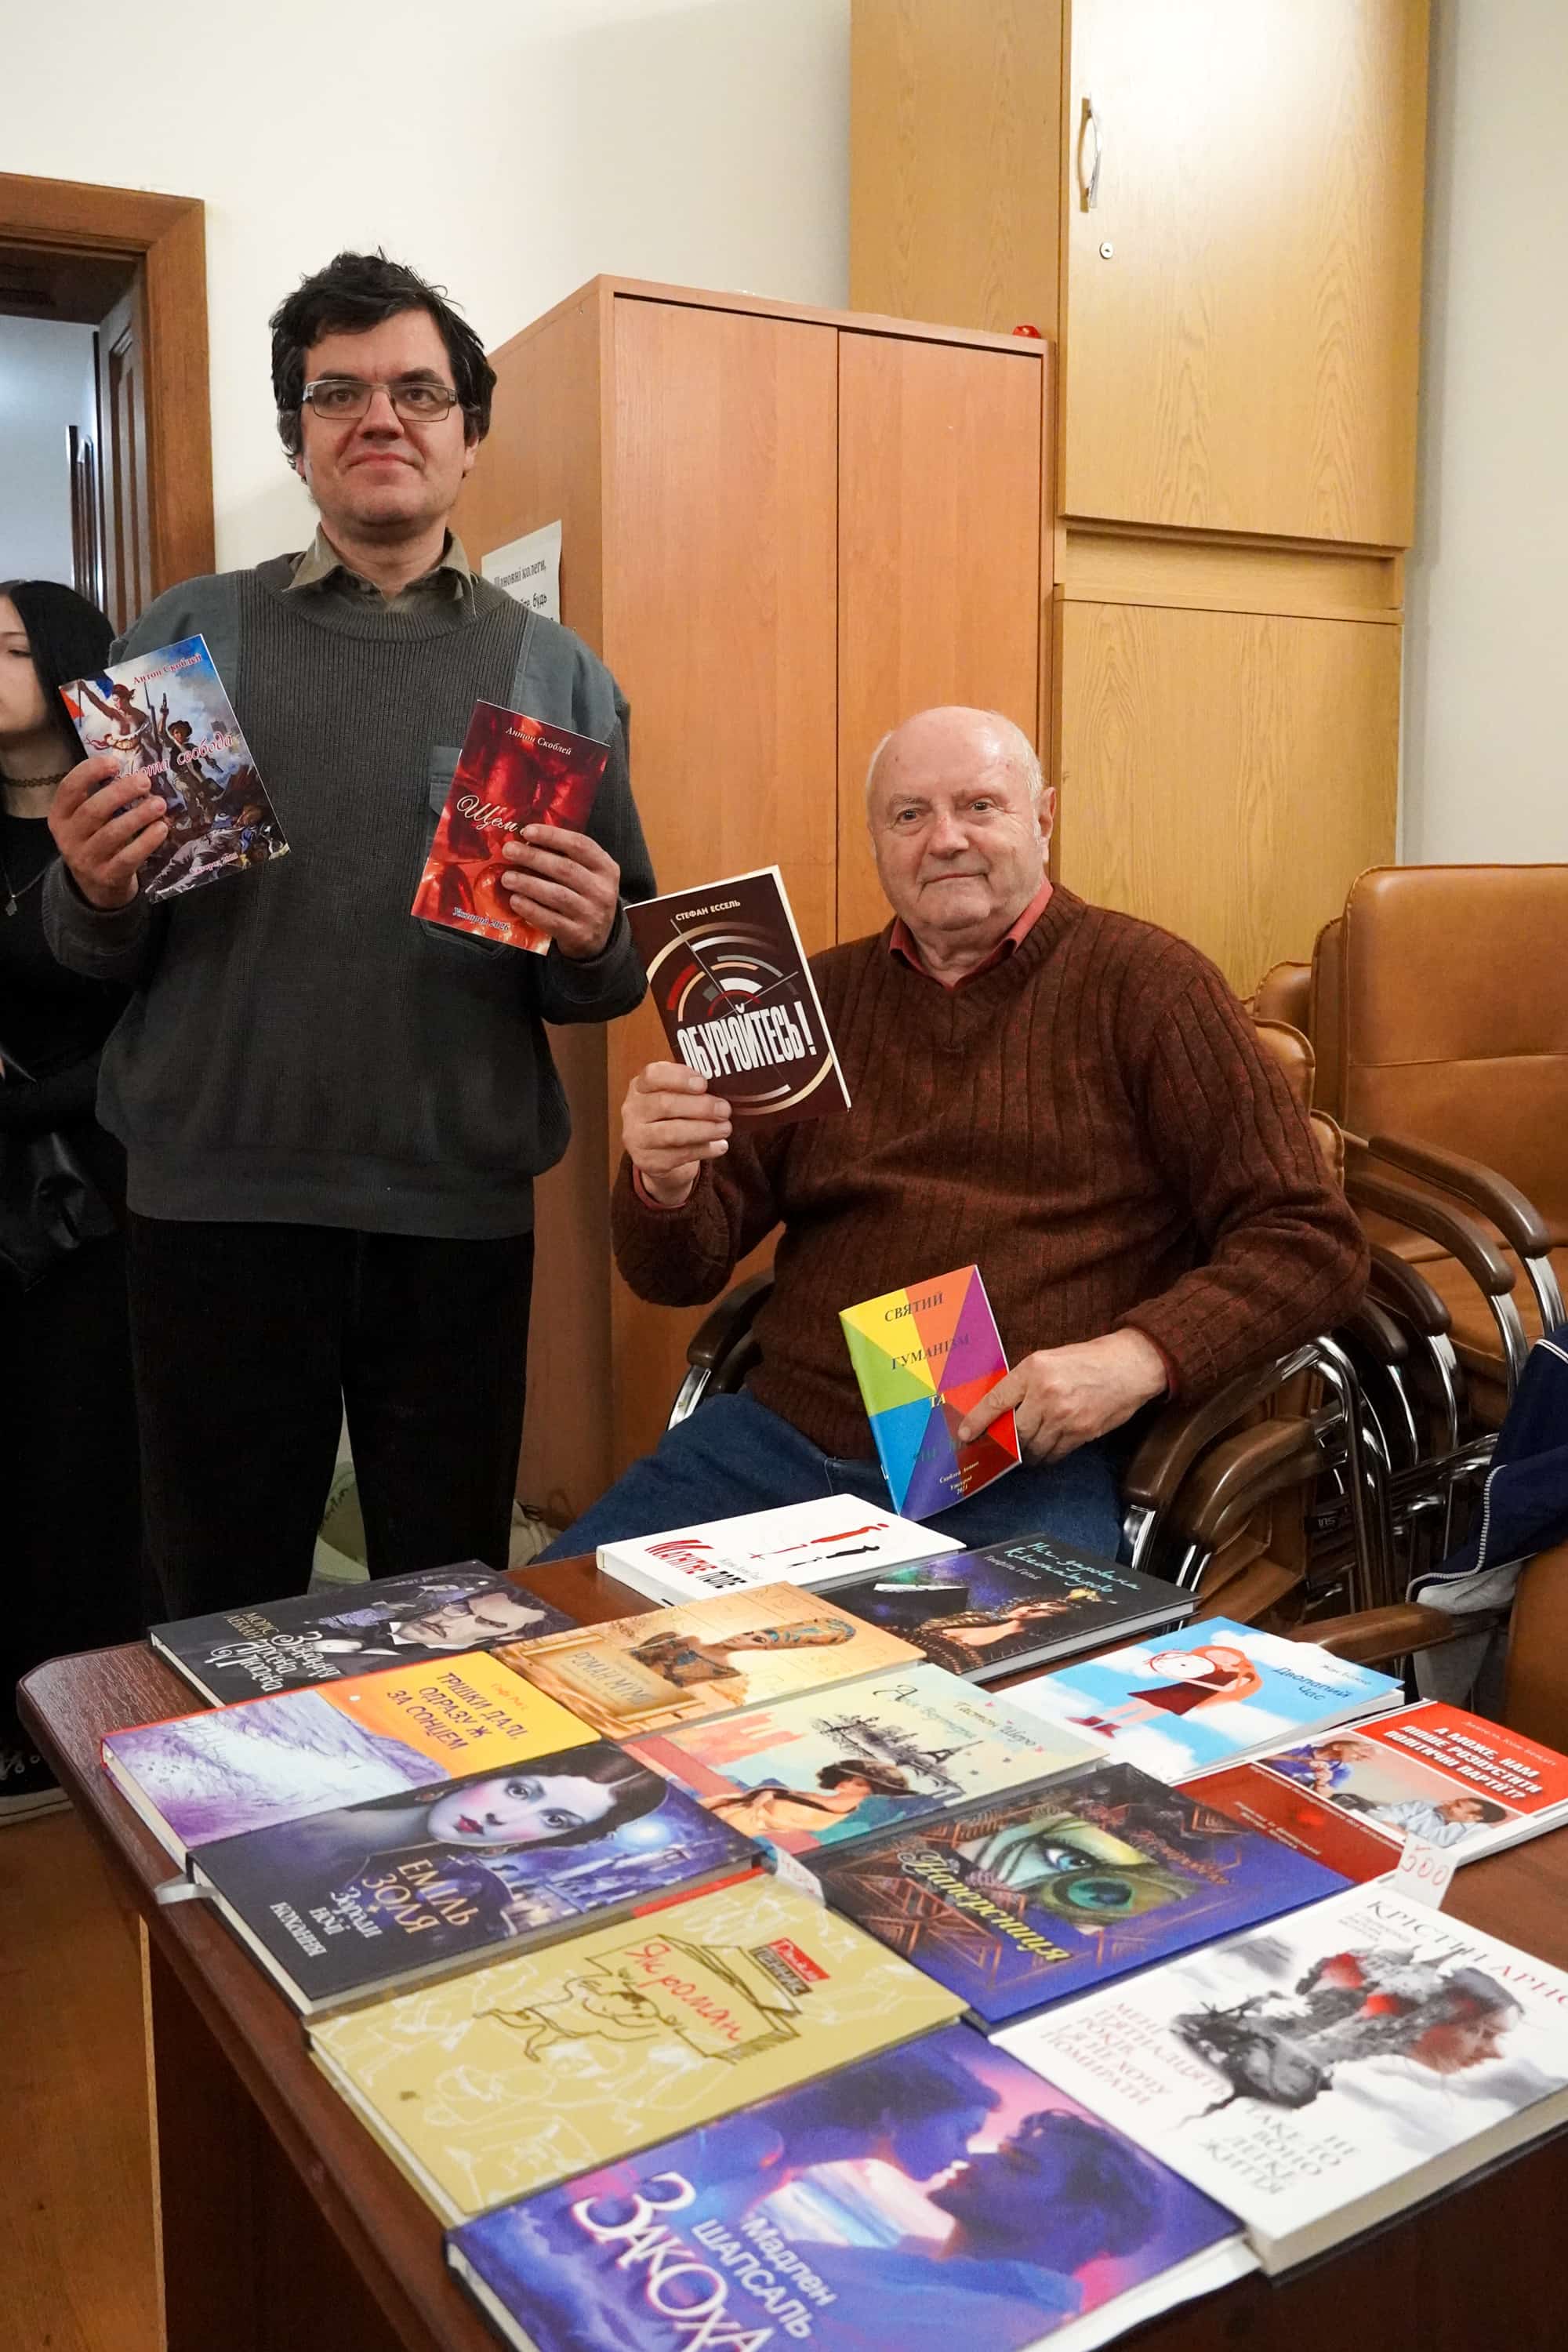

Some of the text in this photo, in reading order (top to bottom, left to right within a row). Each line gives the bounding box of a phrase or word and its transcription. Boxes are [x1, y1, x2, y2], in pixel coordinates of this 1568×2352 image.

[133, 670, 162, 684] Антон
[176, 731, 234, 766] свобода
[506, 727, 572, 755] Антон Скоблей
[456, 795, 517, 832] Щем
[676, 900, 741, 921] СТЕФАН ЕССЕЛЬ
[885, 1292, 944, 1322] СВЯТИЙ
[891, 1334, 971, 1370] ГУМАНІЗМ
[929, 1392, 946, 1409] ТА
[387, 1690, 470, 1751] ЗА СОНЦЕМ
[419, 1686, 478, 1725] ОДРАЗУ
[465, 1726, 493, 1738] Ж
[1433, 1726, 1450, 1735] А
[1498, 1758, 1541, 1778] НАМ
[1446, 1746, 1544, 1794] РОЗПУСТИТИ
[361, 1873, 441, 1935] ЗОЛЯ
[397, 1859, 479, 1927] ЕМІЛЬ
[652, 1971, 743, 2042] роман
[691, 2218, 814, 2339] ШАПСАЛЬ
[741, 2216, 838, 2307] Мадлен
